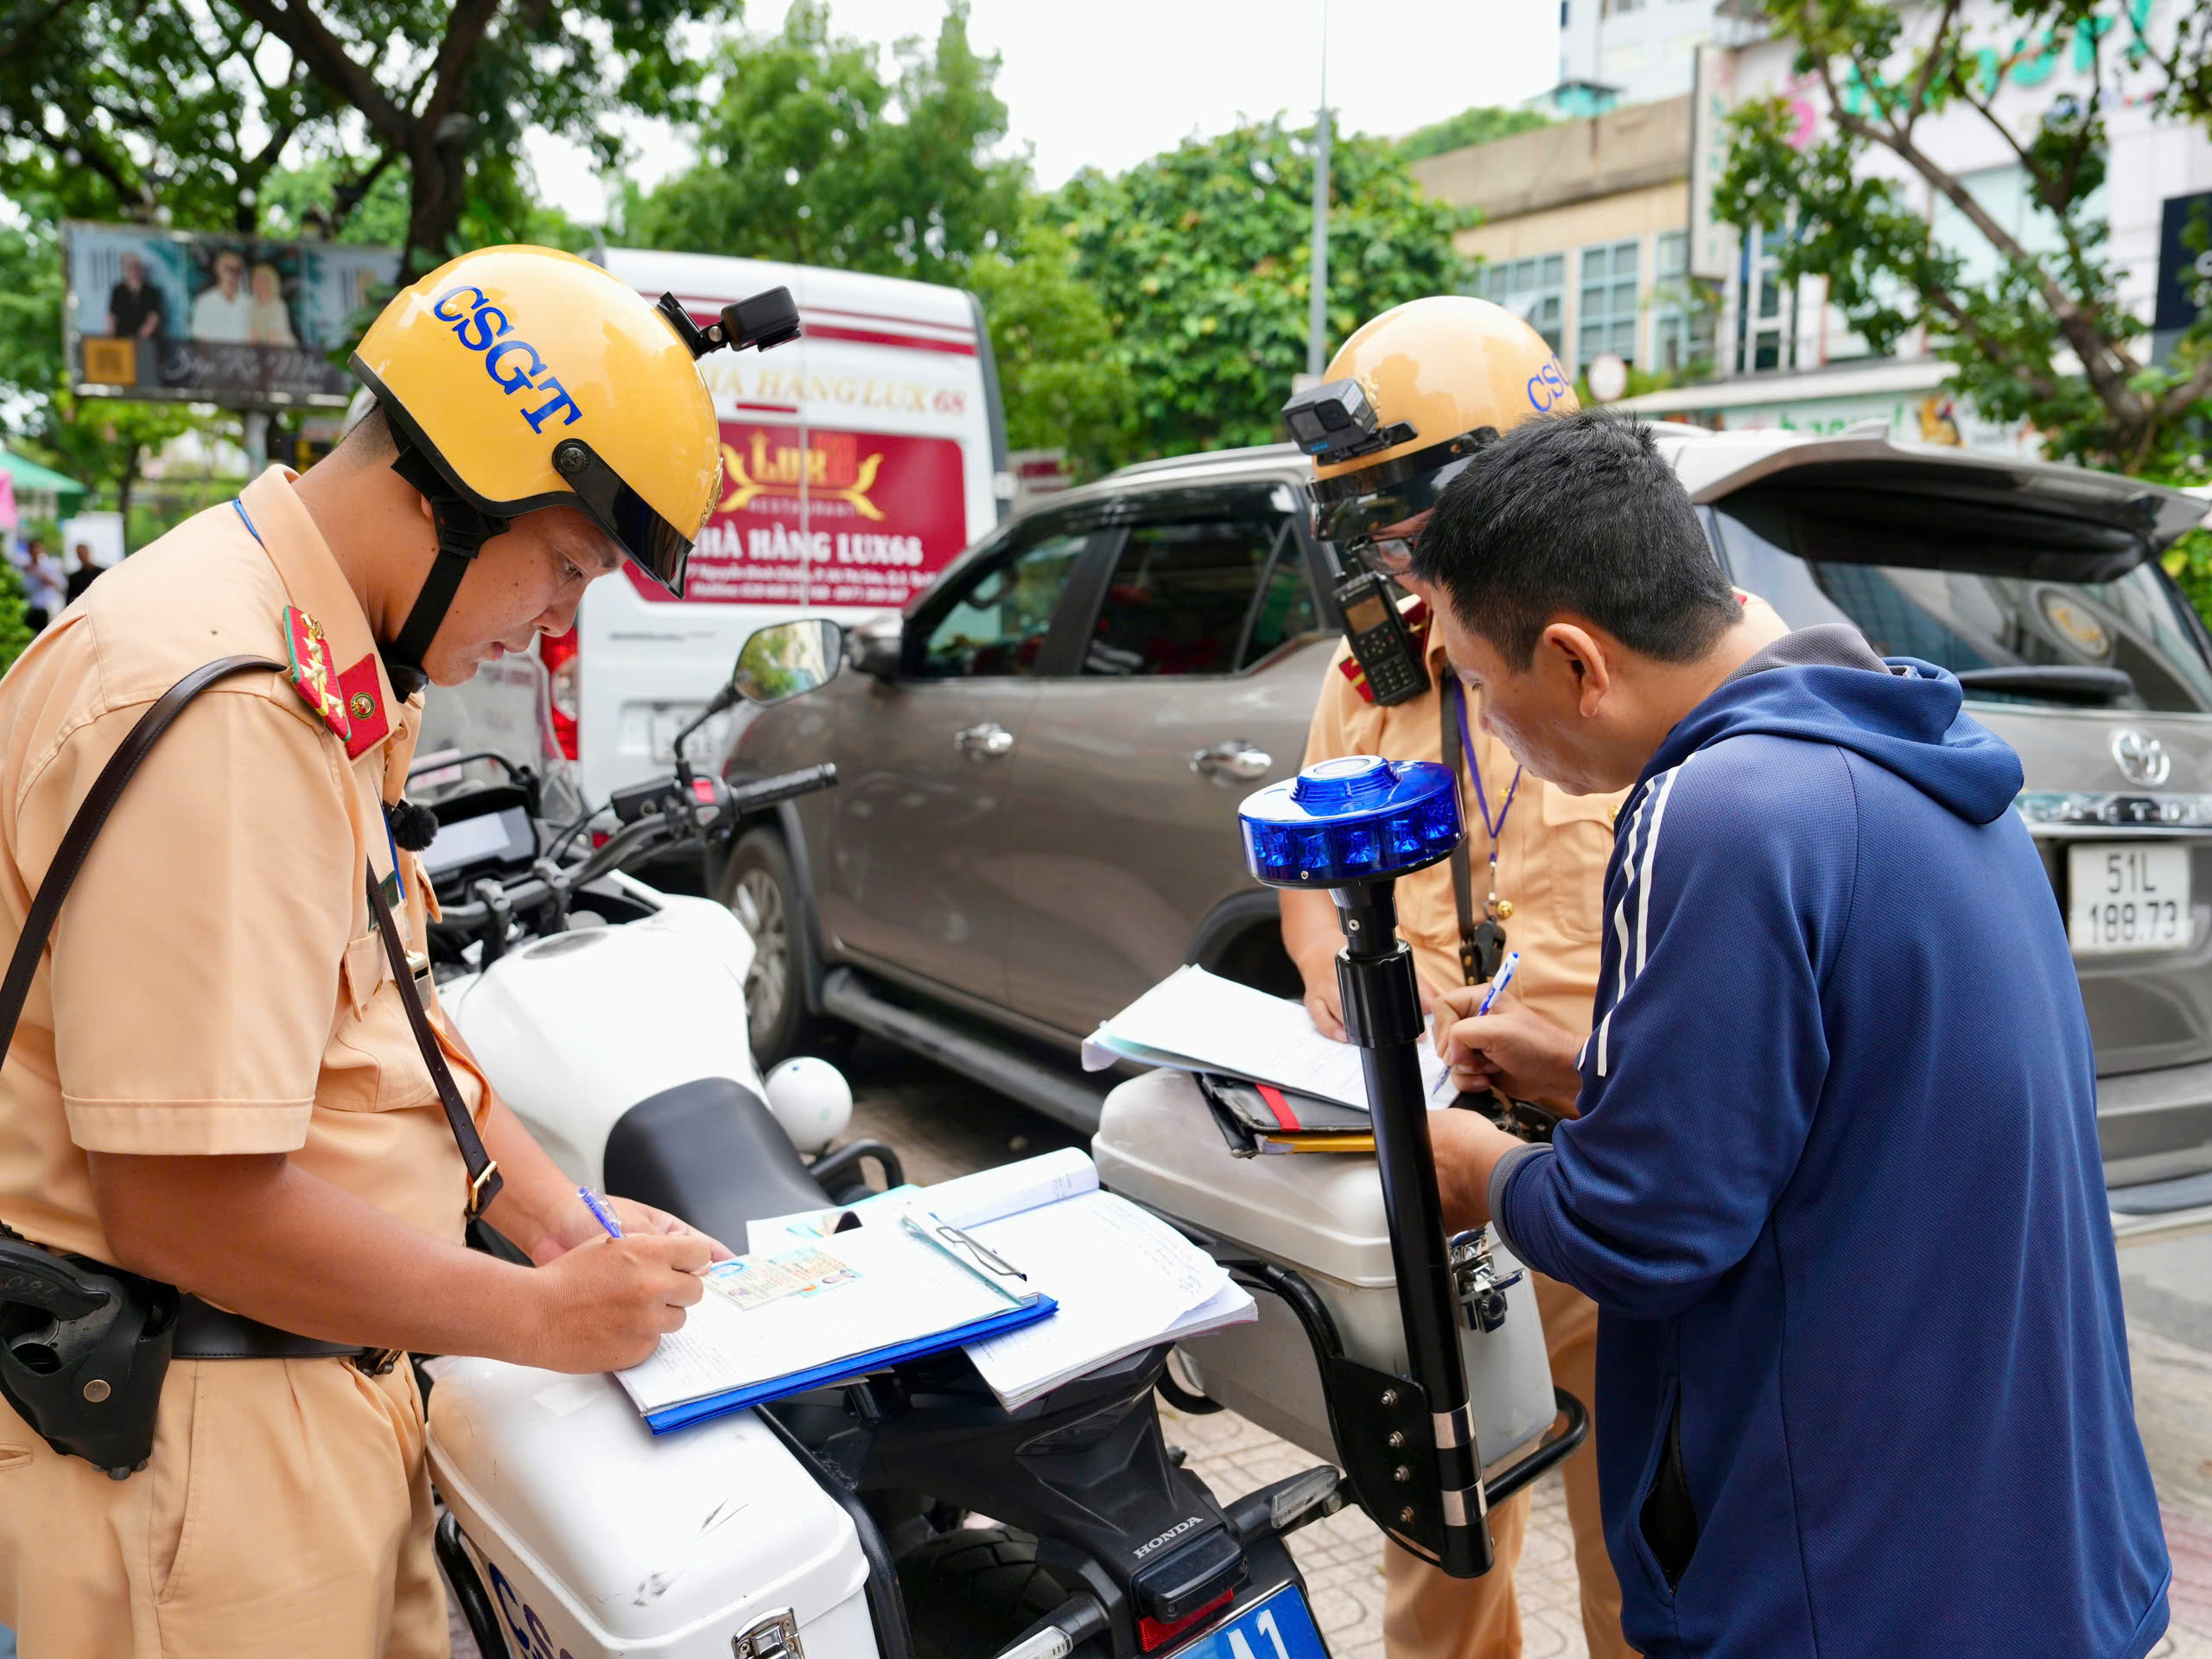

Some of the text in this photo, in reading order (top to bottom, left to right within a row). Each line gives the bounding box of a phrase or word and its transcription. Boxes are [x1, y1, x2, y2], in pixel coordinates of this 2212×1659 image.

[434, 285, 582, 434] CSGT
[1528, 353, 1570, 412] CS
[747, 521, 831, 563] HÀNG
[836, 532, 925, 566] LUX68
[2107, 851, 2157, 893] 51L
[1133, 1516, 1204, 1559] HONDA
